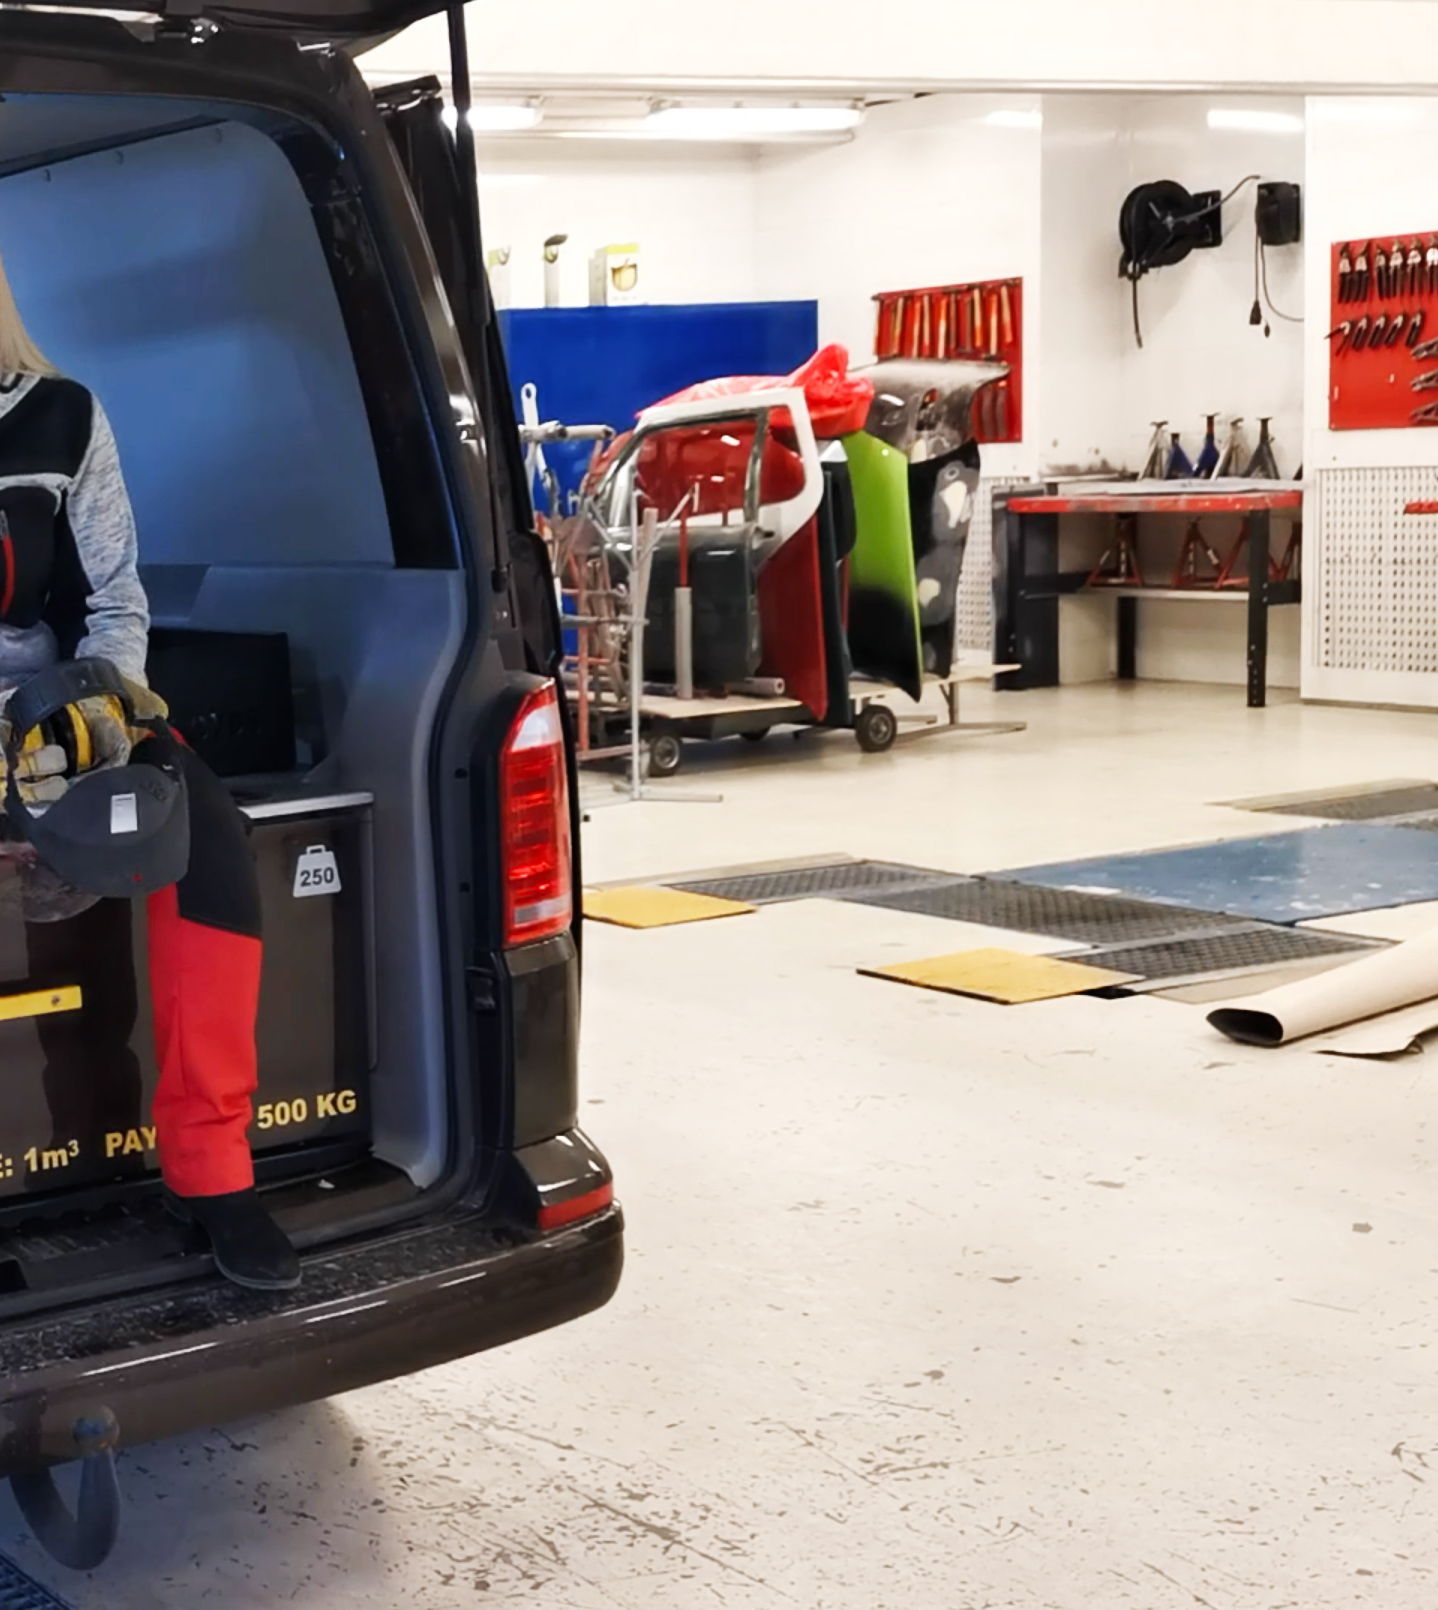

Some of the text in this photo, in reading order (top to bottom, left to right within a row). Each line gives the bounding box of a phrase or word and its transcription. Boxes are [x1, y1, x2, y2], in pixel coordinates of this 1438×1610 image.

[300, 867, 335, 887] 250
[105, 1125, 157, 1158] PAY
[257, 1099, 307, 1129] 500
[317, 1089, 357, 1118] KG
